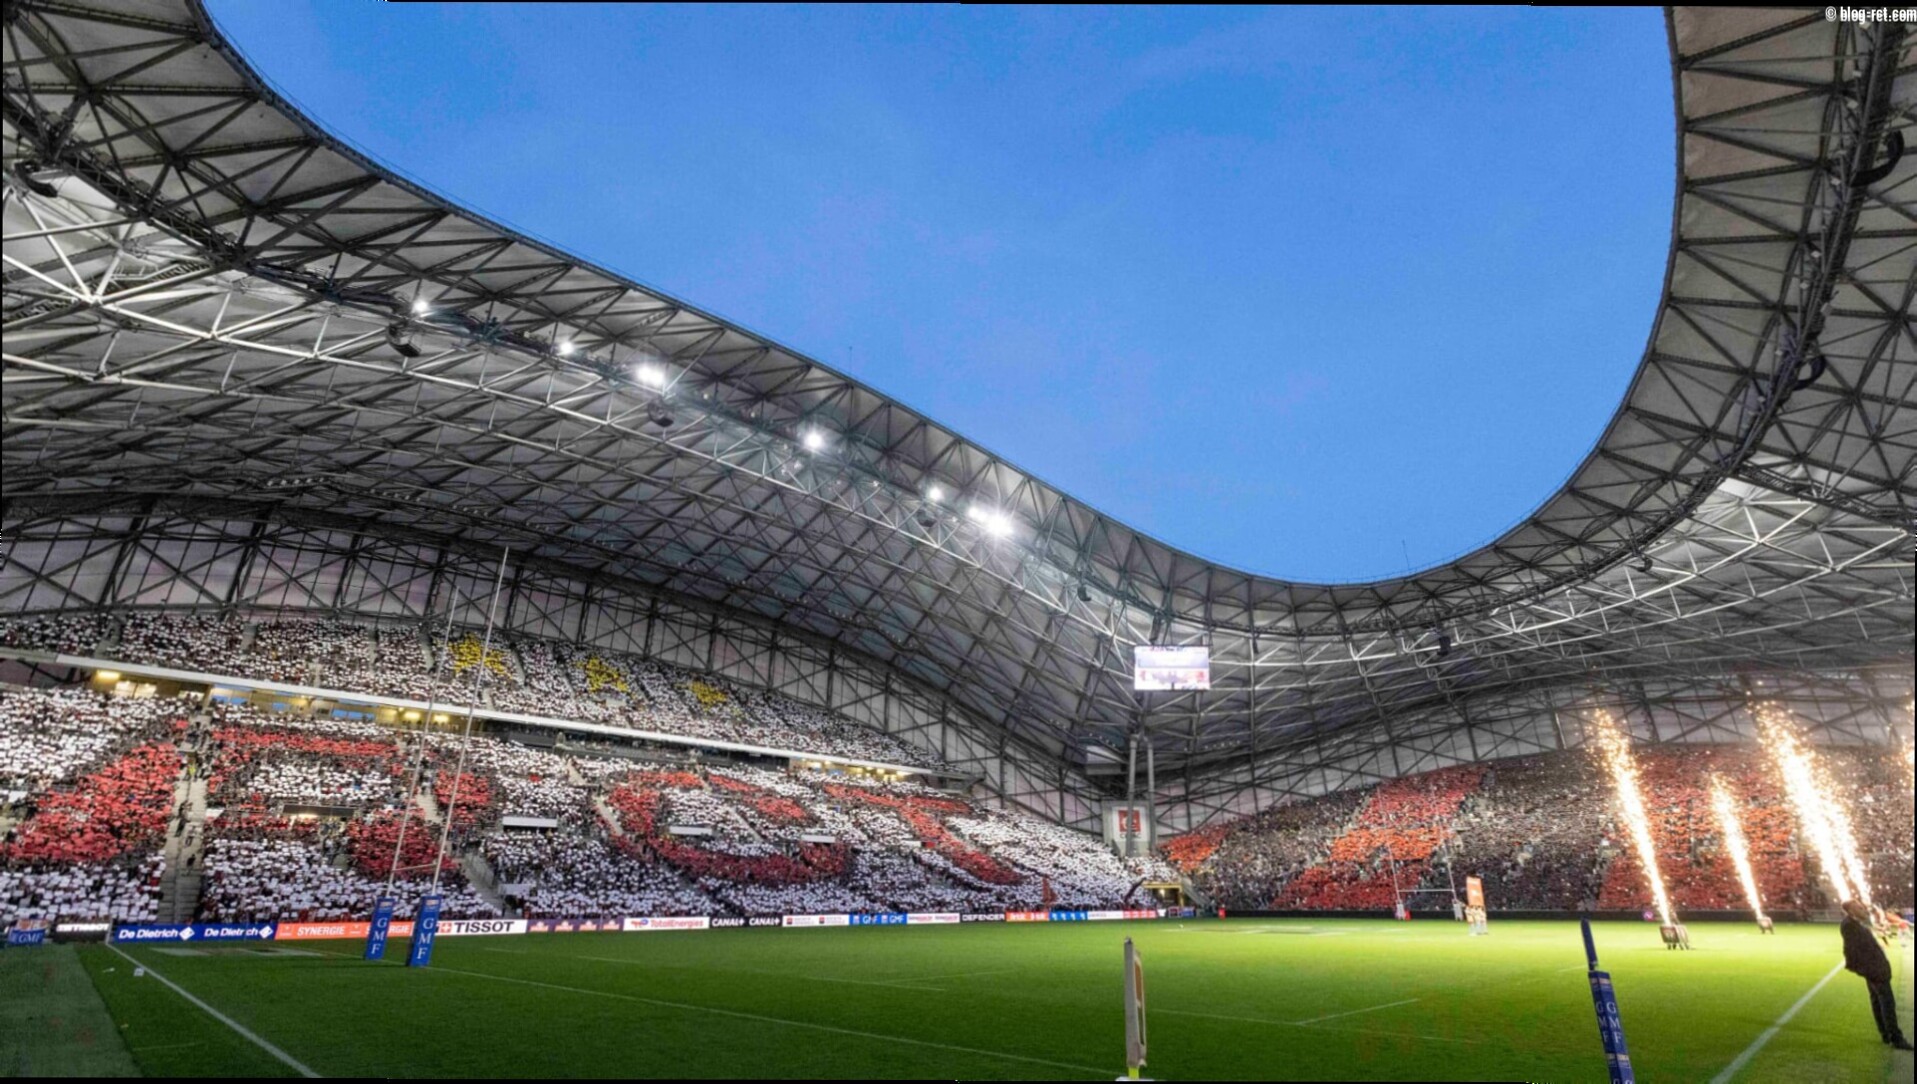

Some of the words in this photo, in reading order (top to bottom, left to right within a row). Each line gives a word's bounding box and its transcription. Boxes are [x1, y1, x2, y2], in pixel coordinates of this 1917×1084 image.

[651, 917, 703, 928] TotalEnergies
[711, 917, 745, 927] CANAL+
[749, 916, 780, 926] CANAL+
[962, 914, 1005, 922] DEFENDER
[204, 928, 219, 937] De
[220, 927, 259, 936] Dietrch
[297, 926, 345, 936] SYNERGIE
[454, 921, 515, 933] TISSOT
[118, 930, 135, 939] De
[136, 928, 178, 938] Dietrich
[371, 917, 388, 955] GMF
[417, 917, 435, 960] GMF
[1606, 1001, 1622, 1044] GMF
